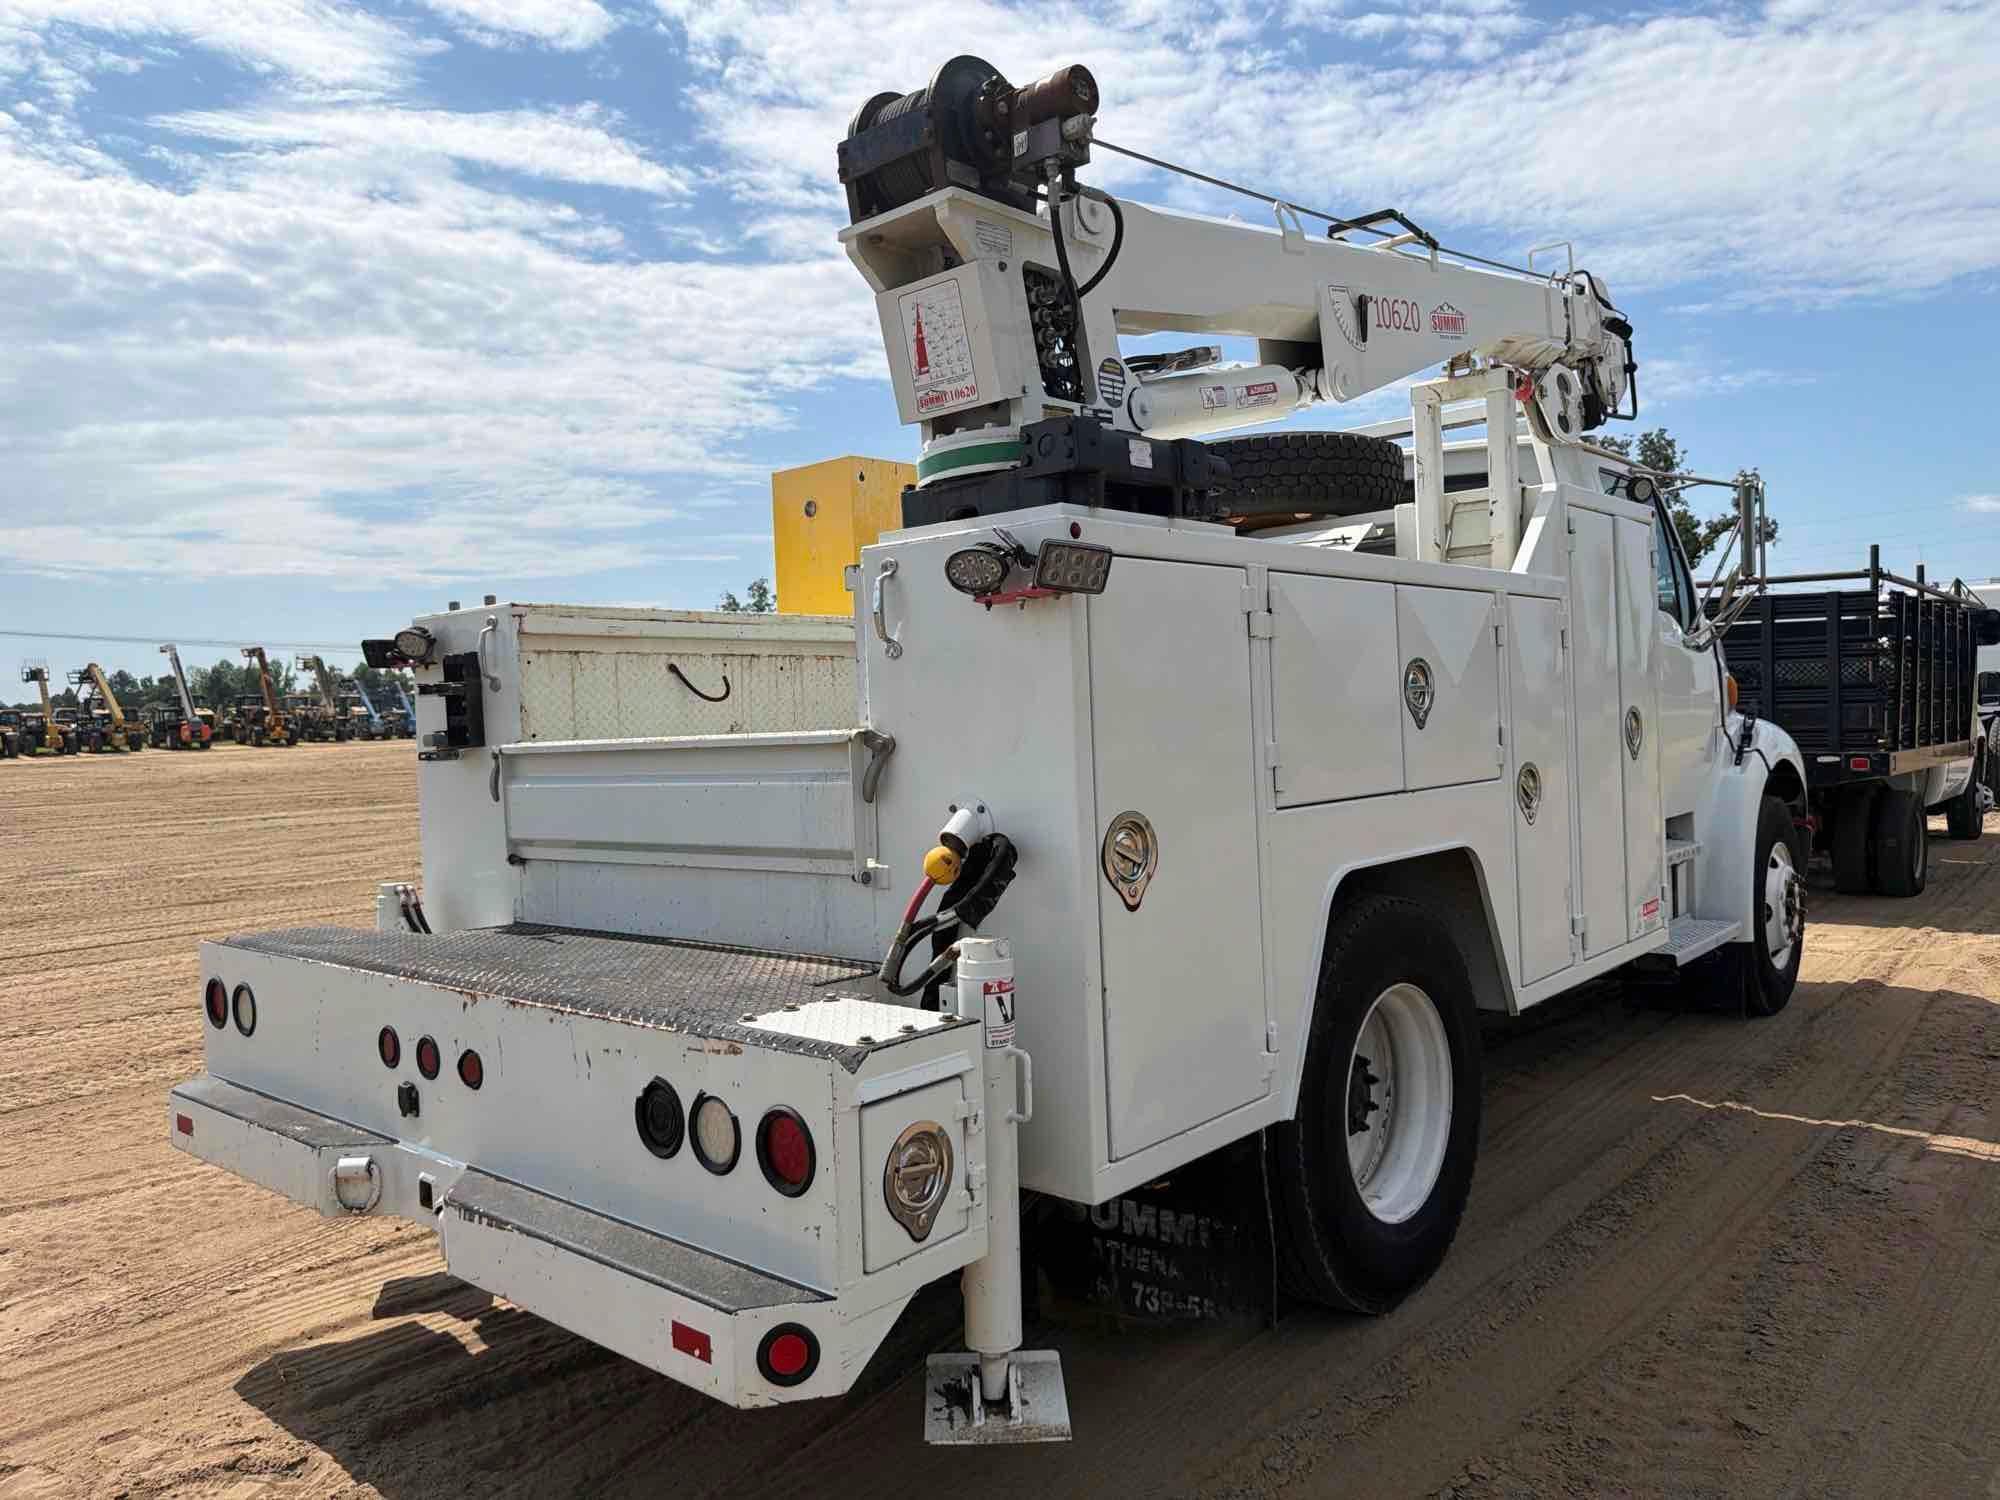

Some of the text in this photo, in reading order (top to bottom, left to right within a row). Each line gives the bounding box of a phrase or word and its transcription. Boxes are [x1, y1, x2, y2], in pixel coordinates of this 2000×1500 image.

[1431, 314, 1465, 332] SUMMIT
[919, 384, 977, 409] SUMMIT 10620
